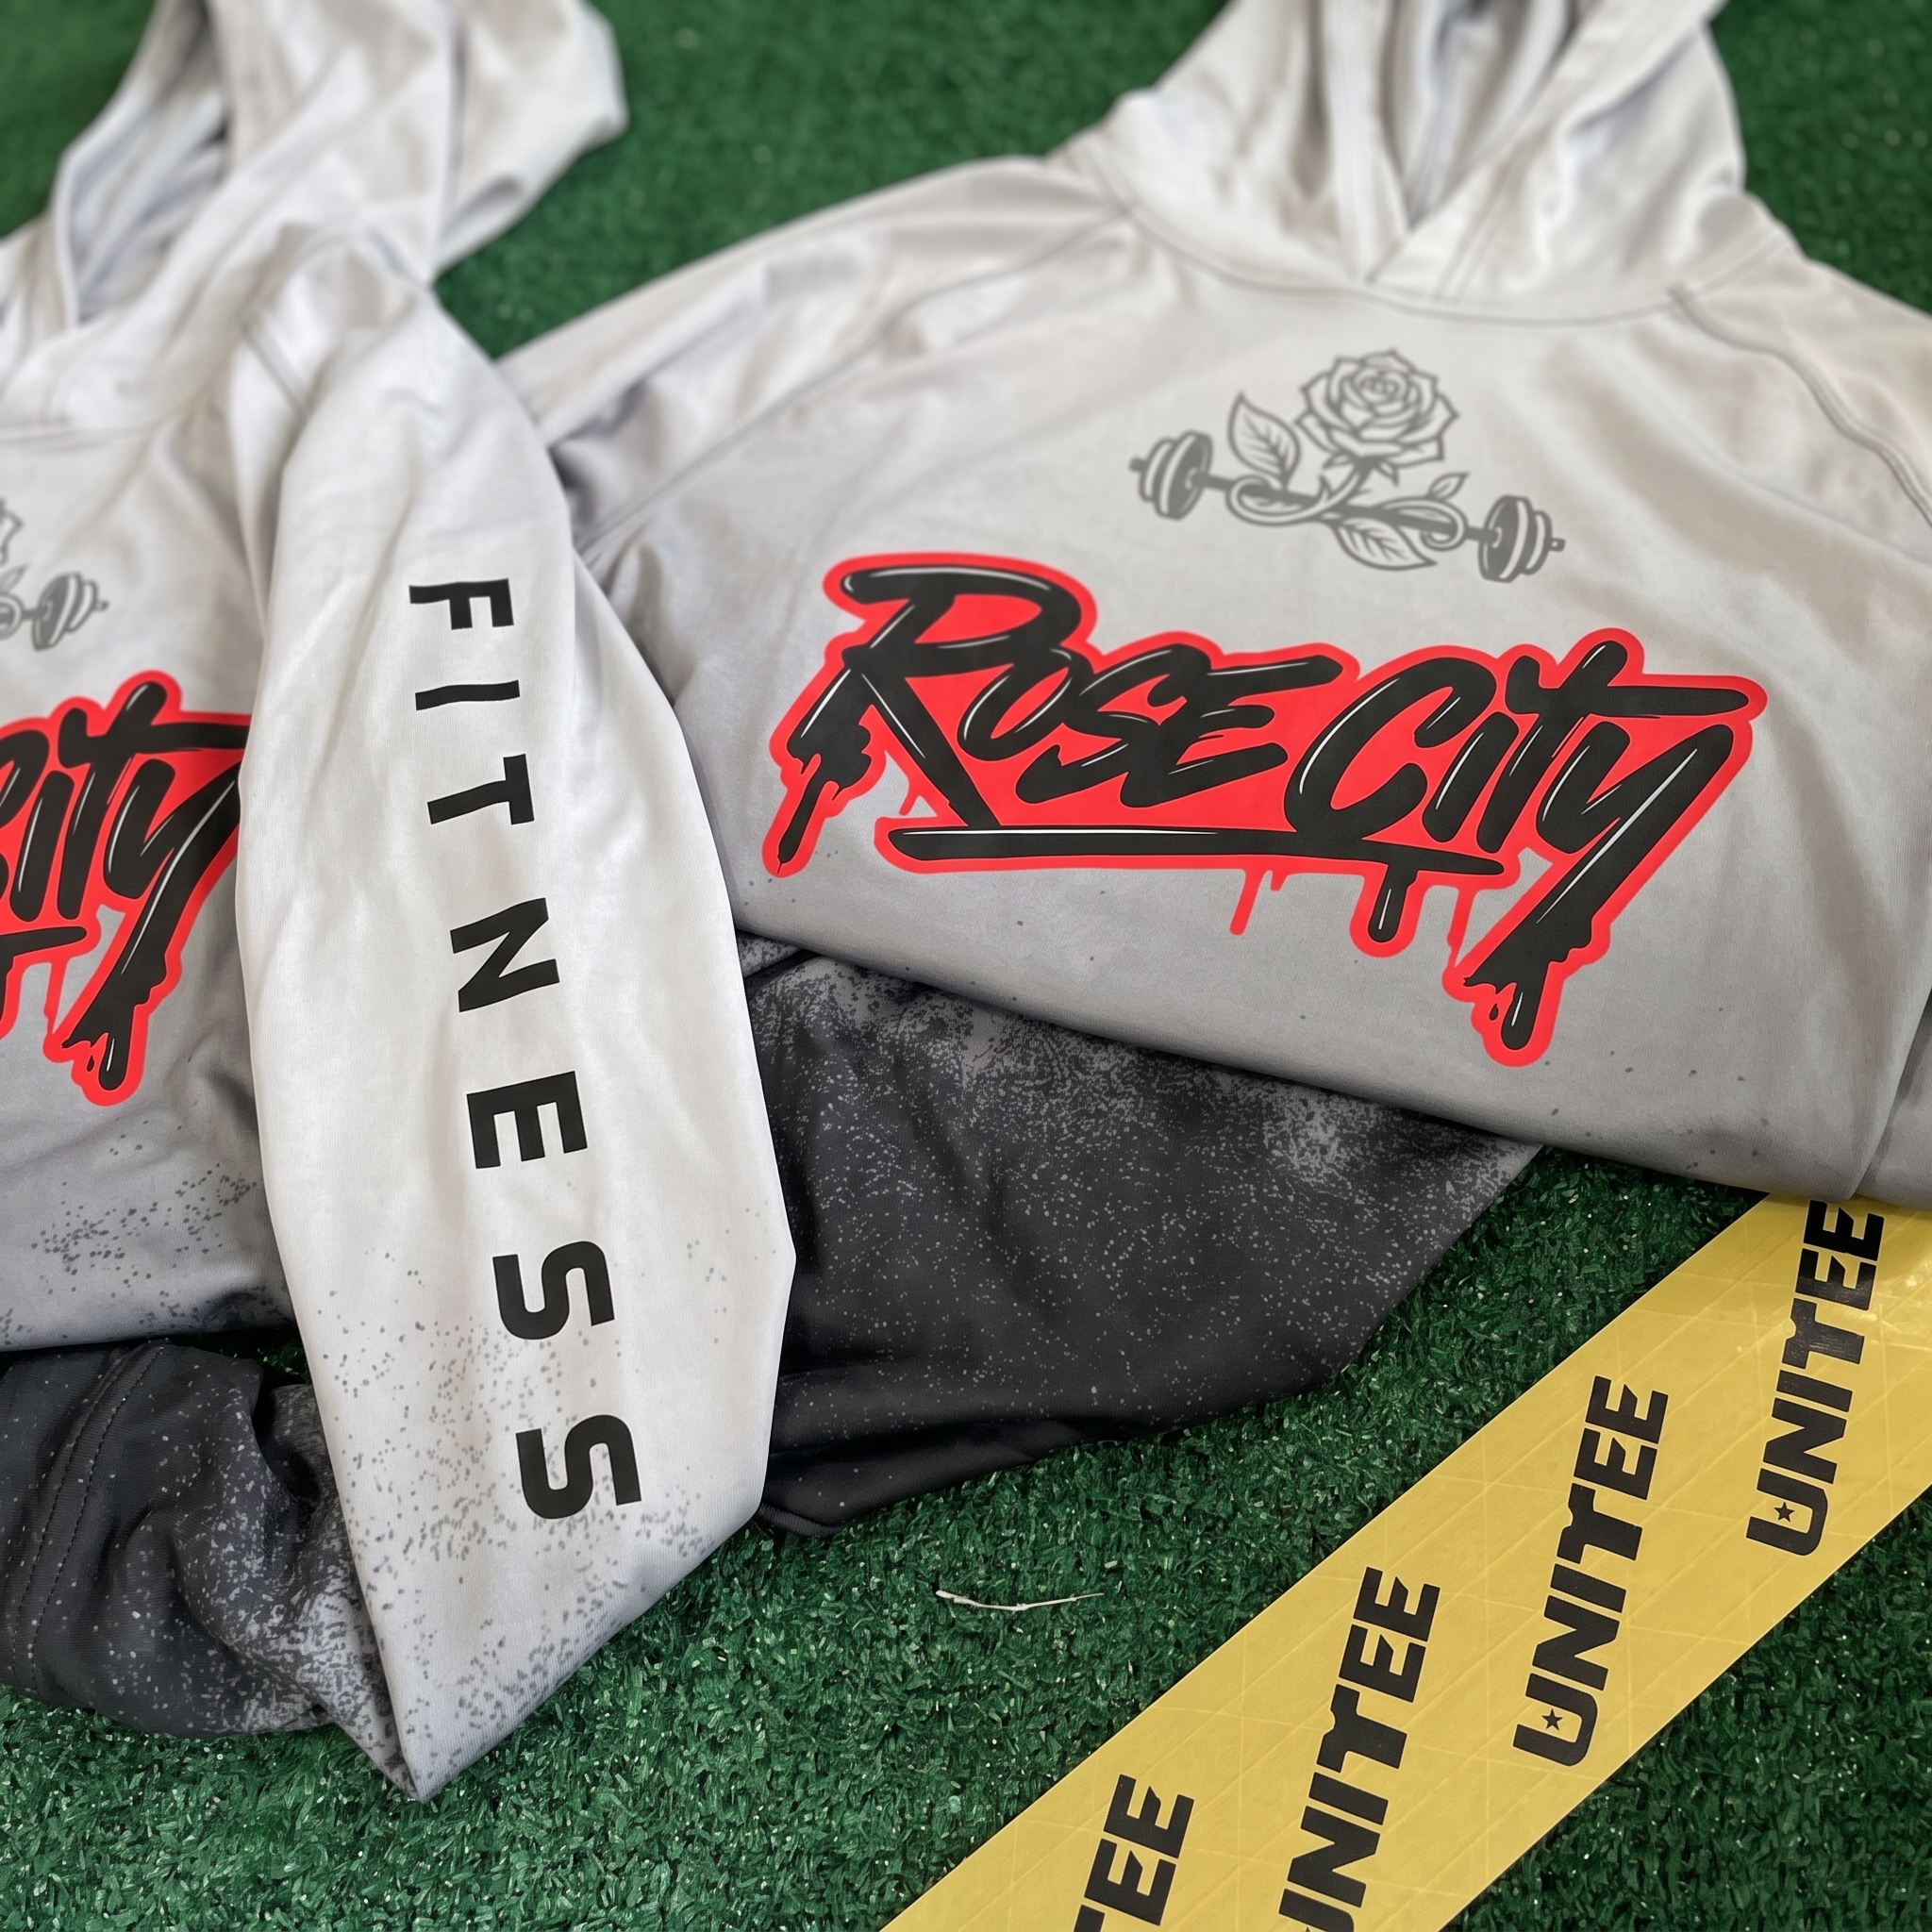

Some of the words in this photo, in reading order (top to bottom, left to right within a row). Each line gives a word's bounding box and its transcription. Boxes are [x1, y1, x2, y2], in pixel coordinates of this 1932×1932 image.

[408, 577, 643, 1521] FITNESS
[1745, 1198, 1886, 1557] UNITEE
[1512, 1375, 1669, 1767] UNITEE
[1073, 1774, 1195, 1932] EE
